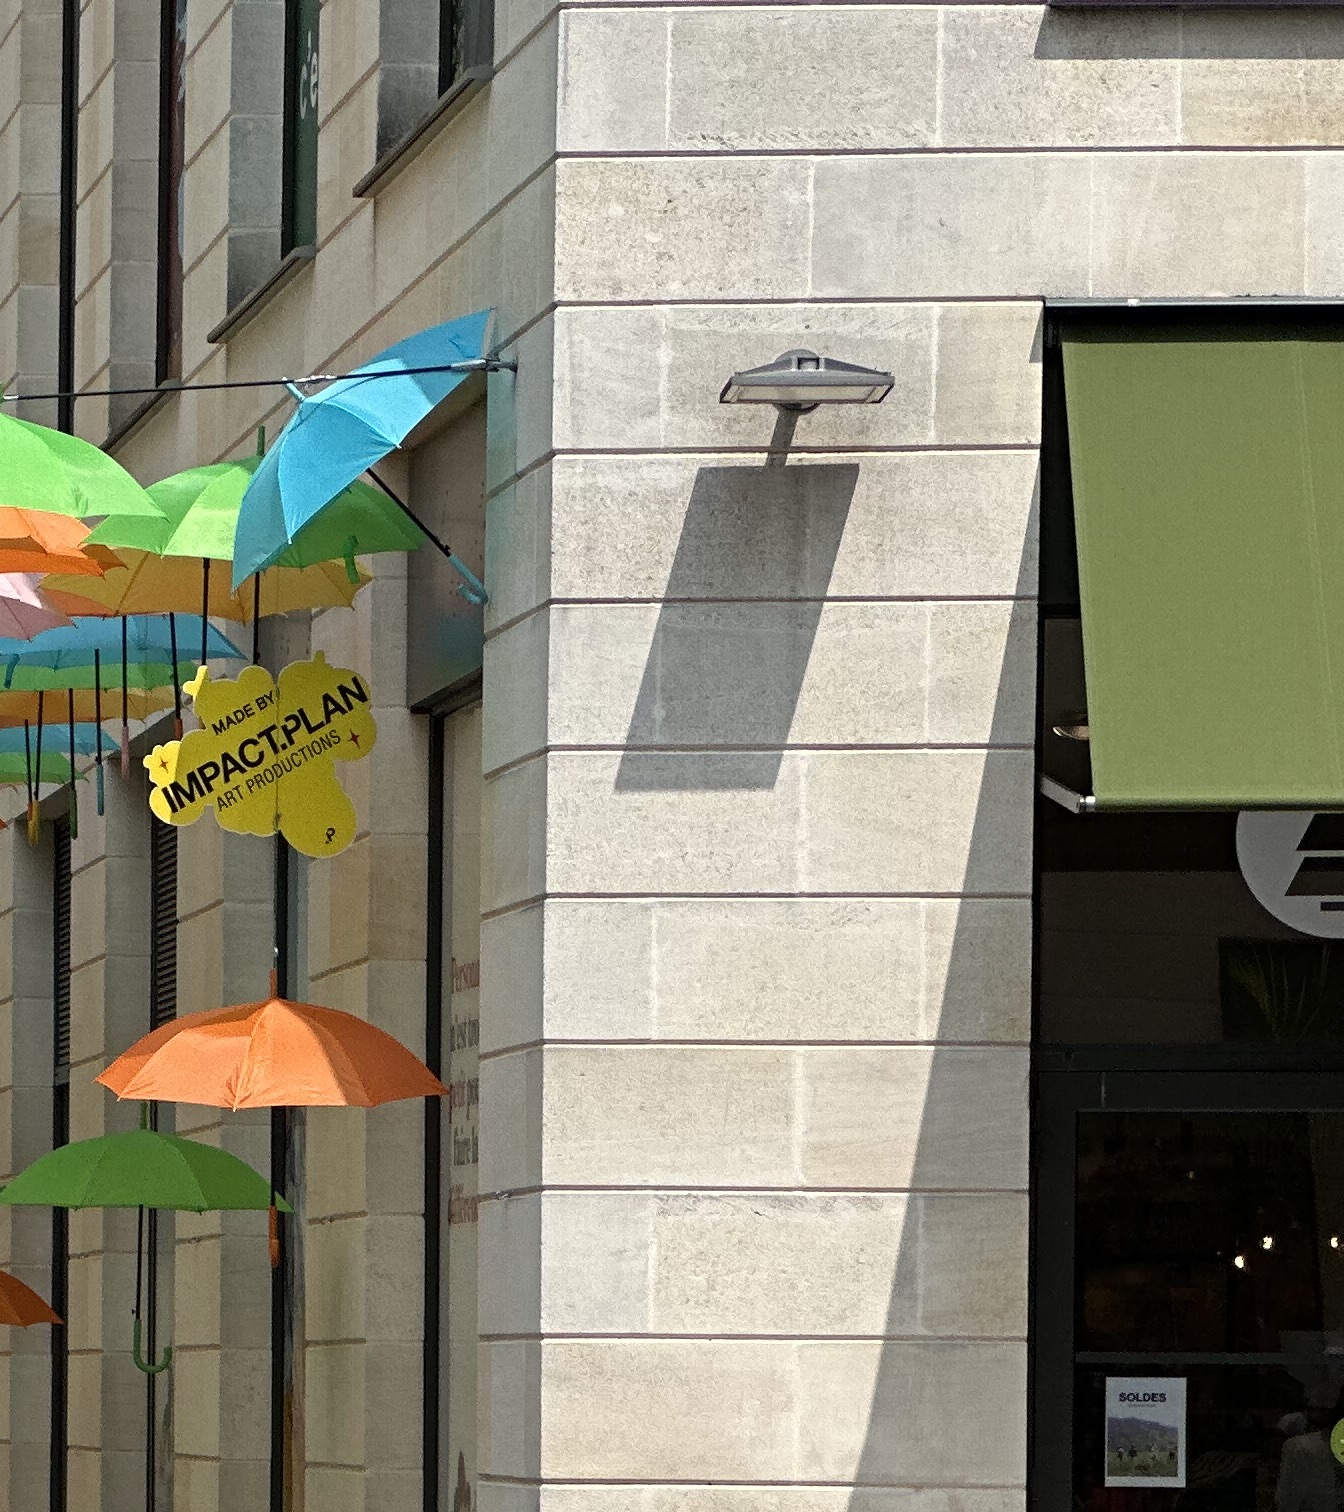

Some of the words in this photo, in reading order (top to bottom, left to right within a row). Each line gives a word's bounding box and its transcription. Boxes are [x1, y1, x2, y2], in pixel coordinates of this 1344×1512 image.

[212, 703, 258, 735] MADE
[258, 690, 276, 715] BY
[161, 676, 370, 814] IMPACT.PLAN
[216, 786, 243, 812] ART
[246, 729, 341, 795] PRODUCTIONS
[1118, 1392, 1167, 1403] SOLDES
